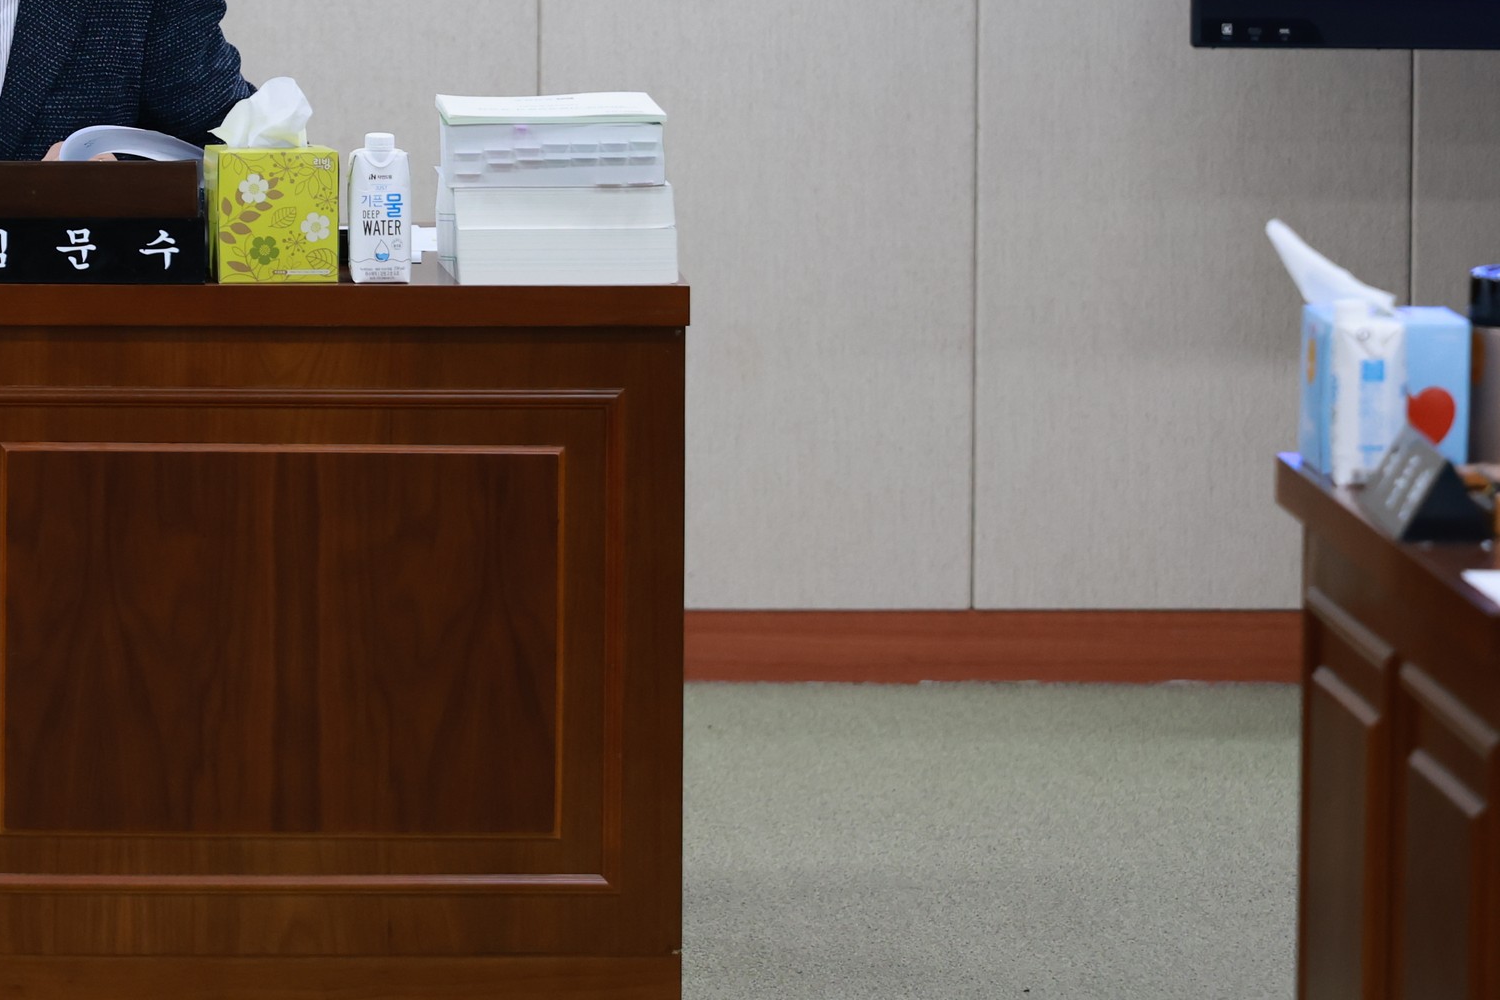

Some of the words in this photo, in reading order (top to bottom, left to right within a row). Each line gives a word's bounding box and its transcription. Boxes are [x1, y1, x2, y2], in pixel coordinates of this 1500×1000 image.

[362, 209, 381, 219] DEEP
[383, 193, 403, 218] 물
[362, 219, 402, 236] WATER
